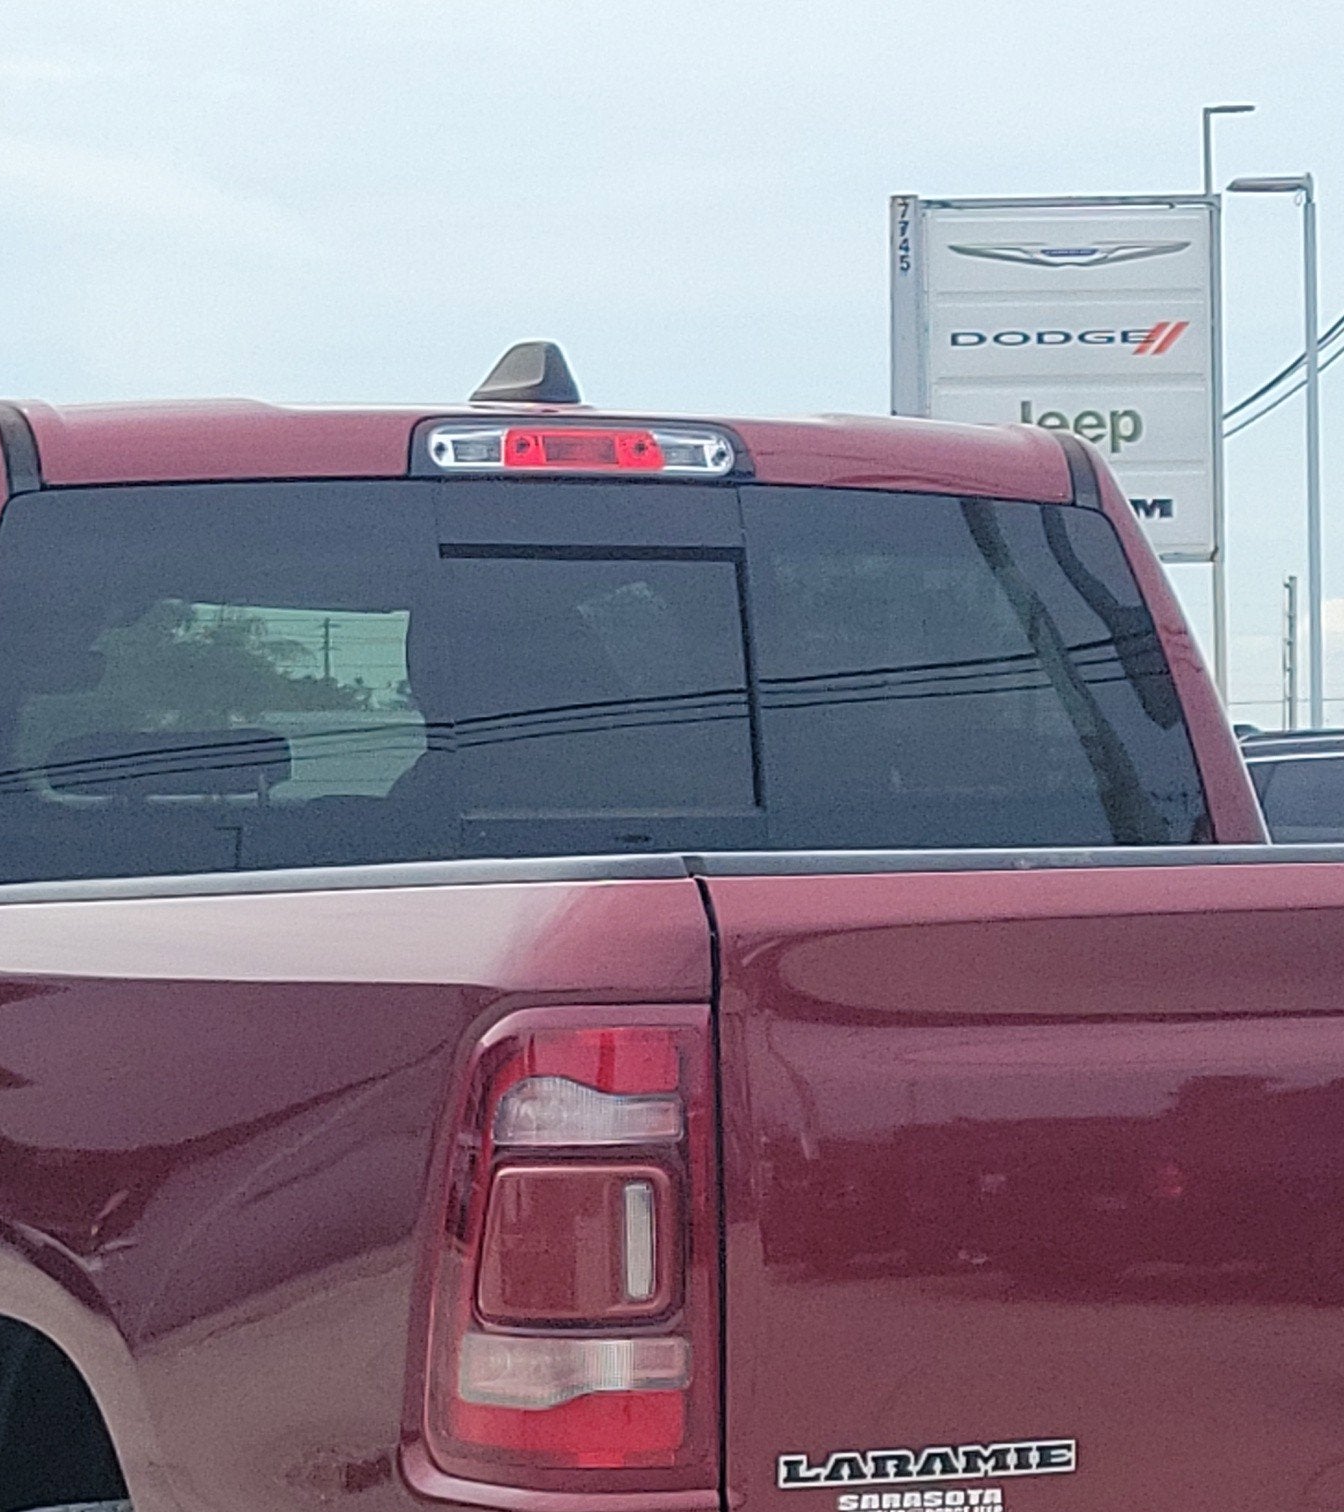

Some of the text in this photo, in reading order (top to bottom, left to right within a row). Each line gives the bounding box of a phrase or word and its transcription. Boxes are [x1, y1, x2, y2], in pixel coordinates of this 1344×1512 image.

[950, 330, 1157, 347] DODGE
[778, 1438, 1077, 1489] LARAMIE
[837, 1488, 1003, 1511] SARASOTA
